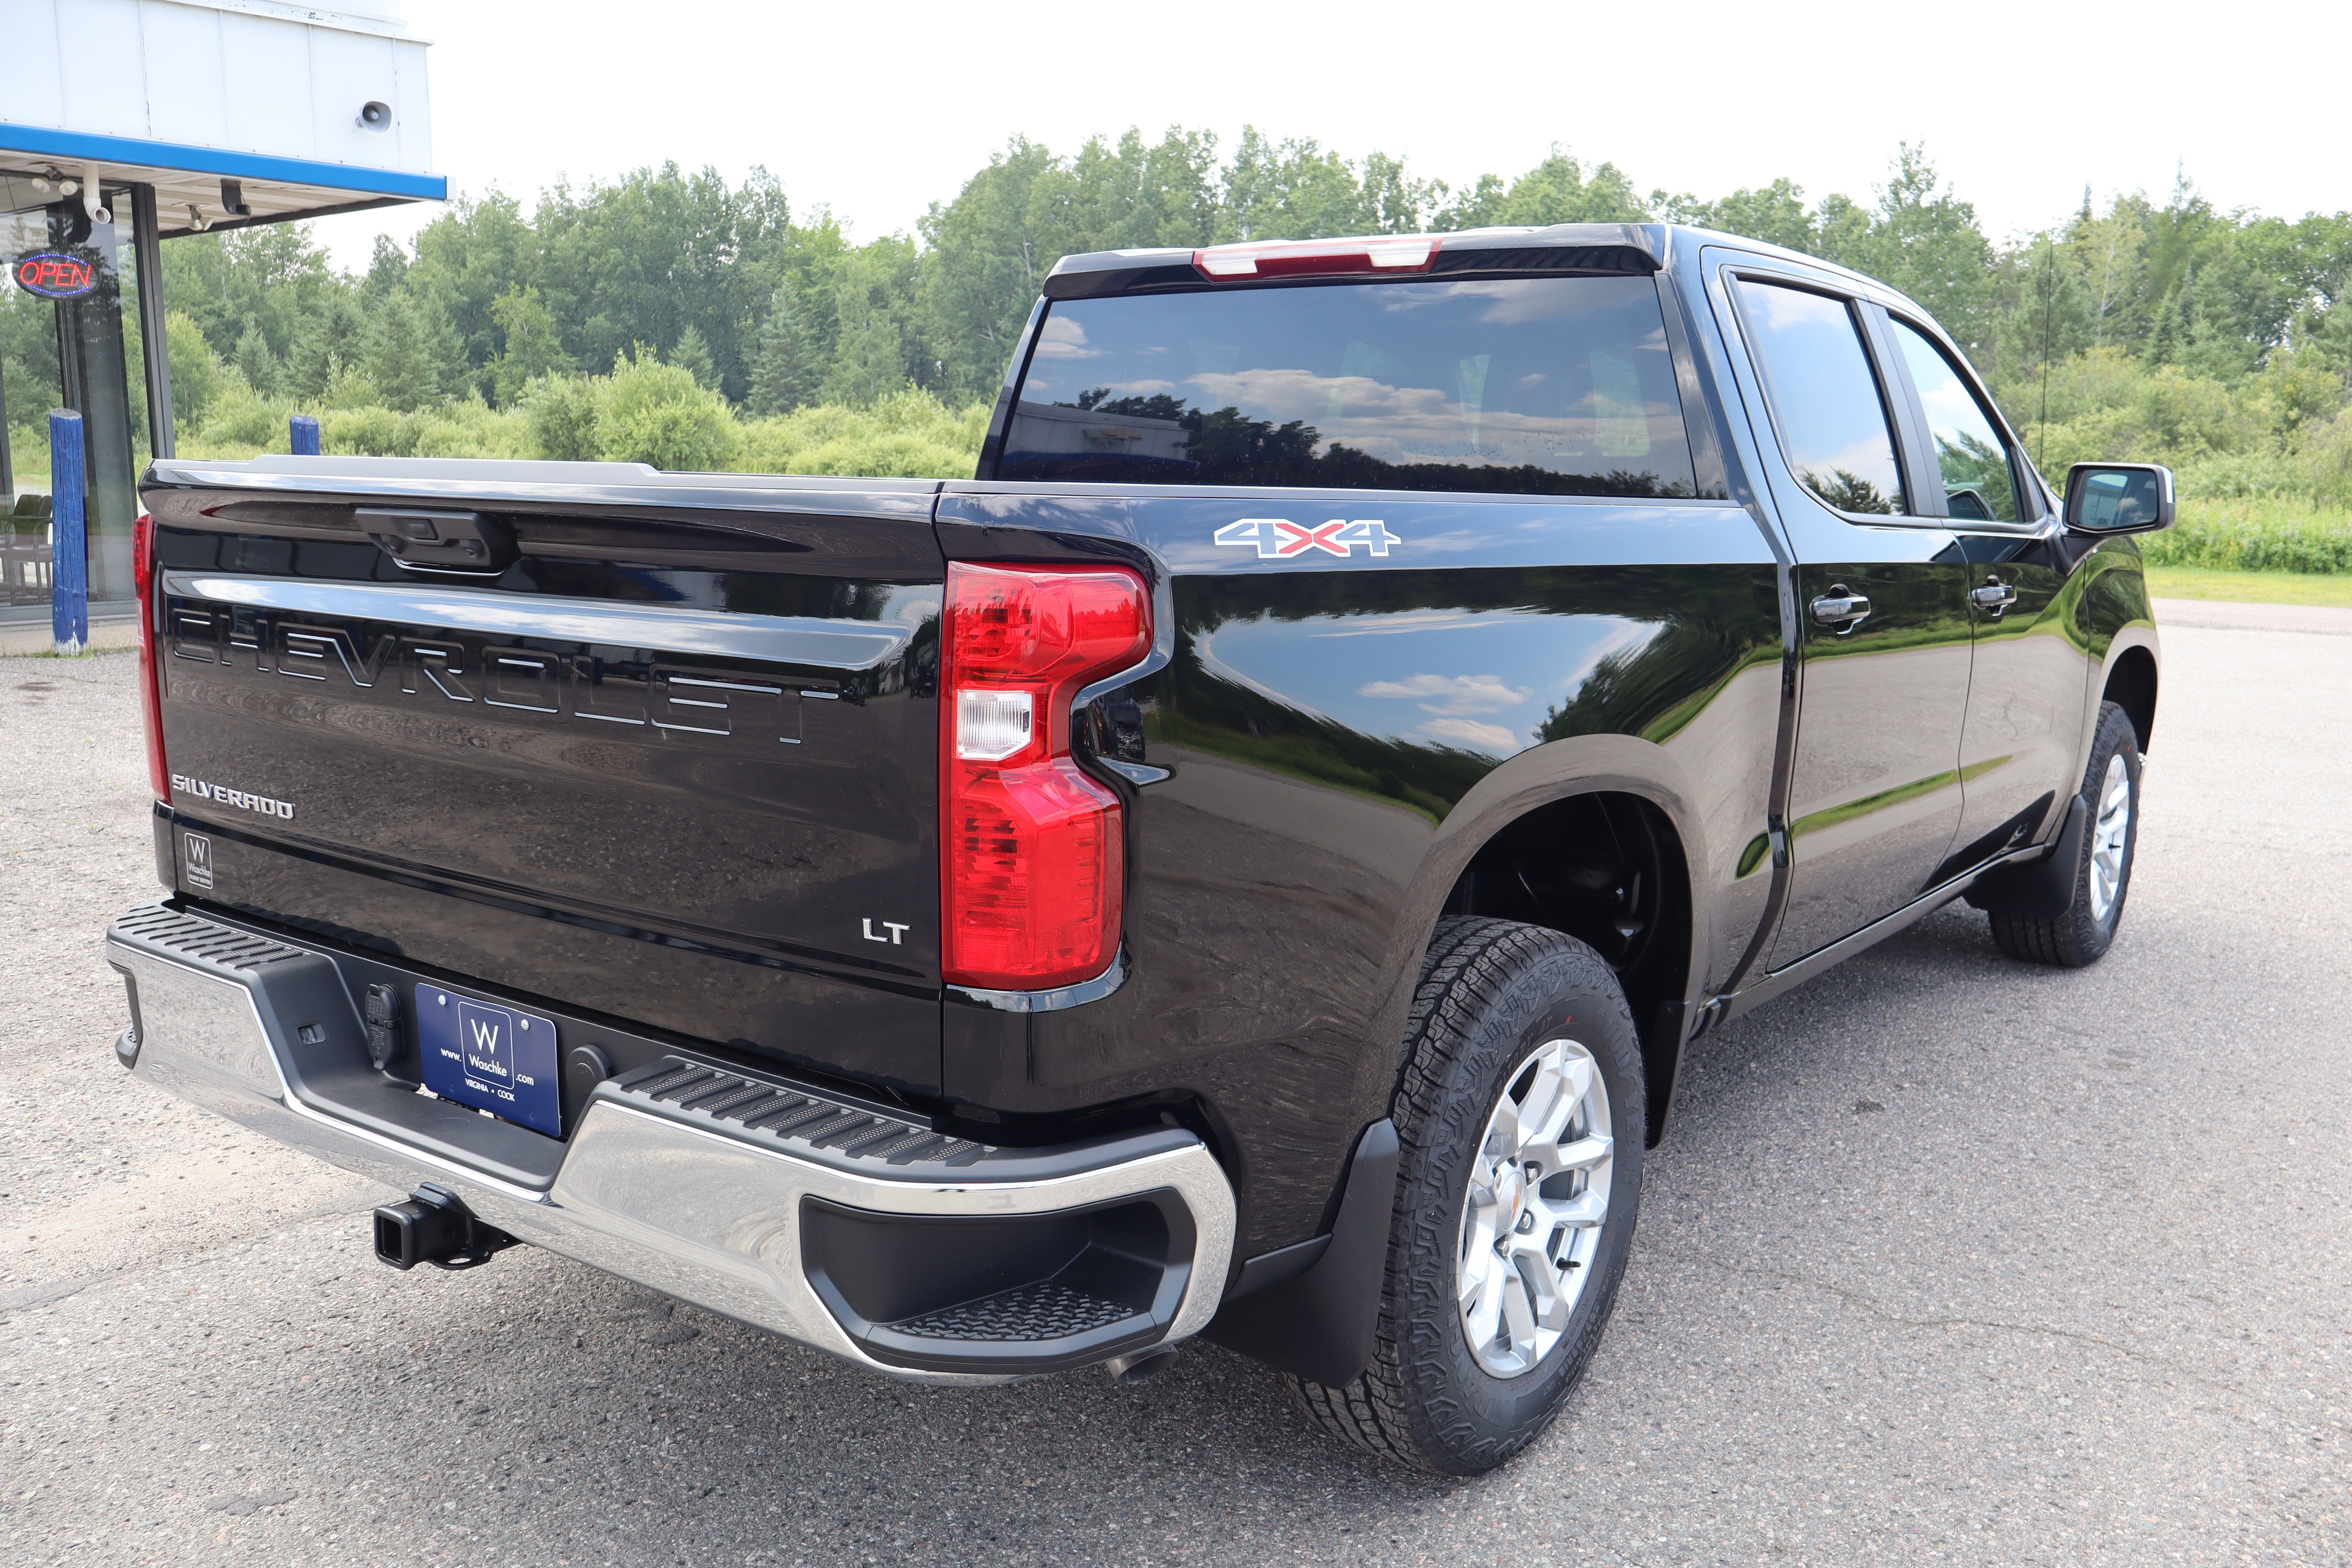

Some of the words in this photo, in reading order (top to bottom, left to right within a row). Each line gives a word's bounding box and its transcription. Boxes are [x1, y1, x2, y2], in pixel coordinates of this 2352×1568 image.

[20, 262, 92, 286] OPEN
[172, 608, 840, 744] CHEVROLET
[172, 774, 296, 820] SILVERADO
[190, 838, 205, 863] W
[188, 862, 211, 877] Waschke
[862, 918, 911, 945] LT
[471, 1018, 499, 1054] W
[441, 1048, 462, 1062] www.
[468, 1053, 507, 1077] Waschke
[515, 1074, 534, 1086] .com
[465, 1078, 488, 1093] VIRGINIA
[498, 1089, 515, 1102] COOK
[1592, 1006, 1639, 1185] GOODYEAR
